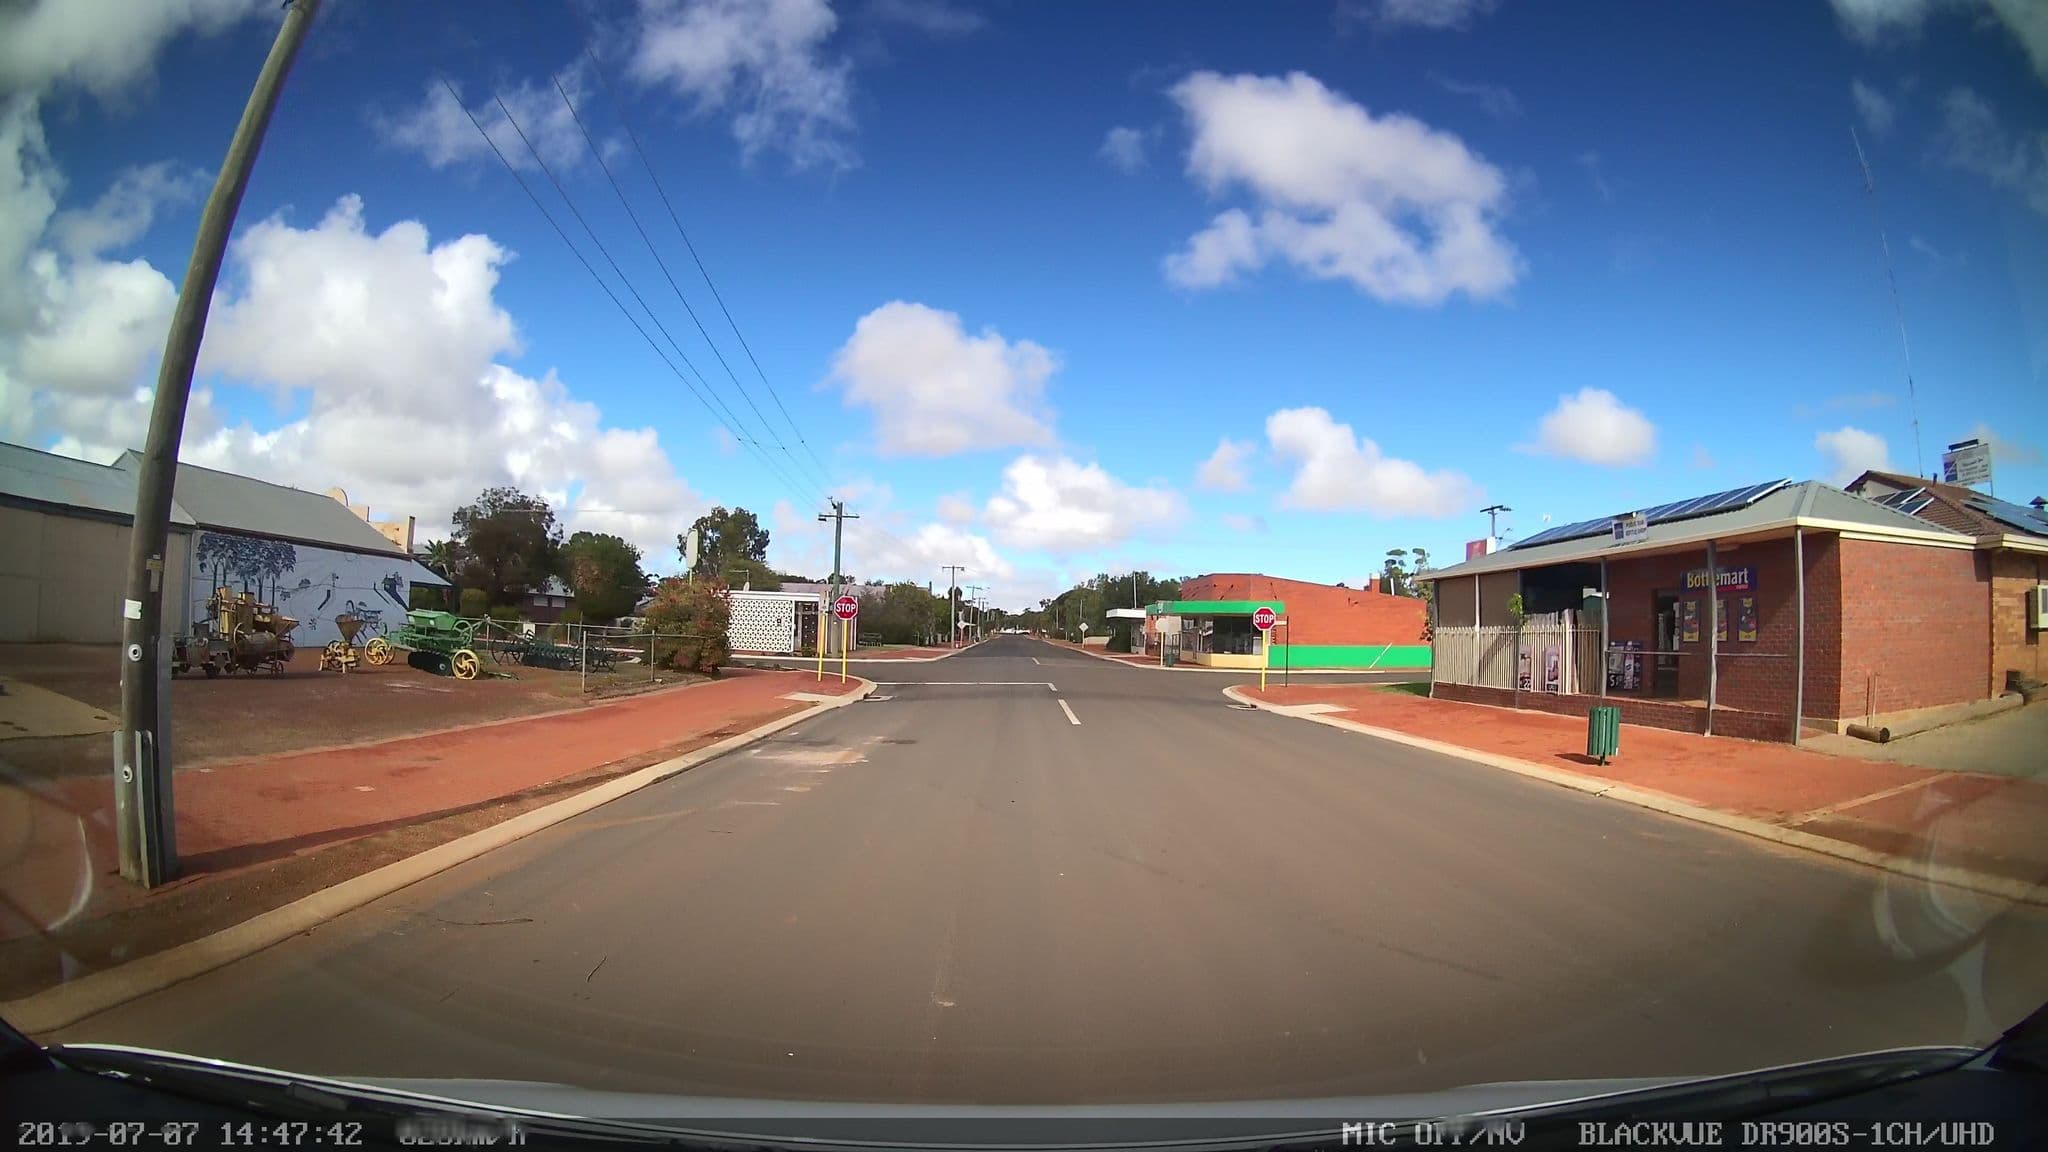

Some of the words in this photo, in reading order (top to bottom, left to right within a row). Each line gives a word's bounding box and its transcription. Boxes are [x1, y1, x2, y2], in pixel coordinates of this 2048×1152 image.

[1687, 567, 1749, 588] Bottemart
[836, 603, 856, 613] STOP
[1255, 614, 1274, 623] STOP
